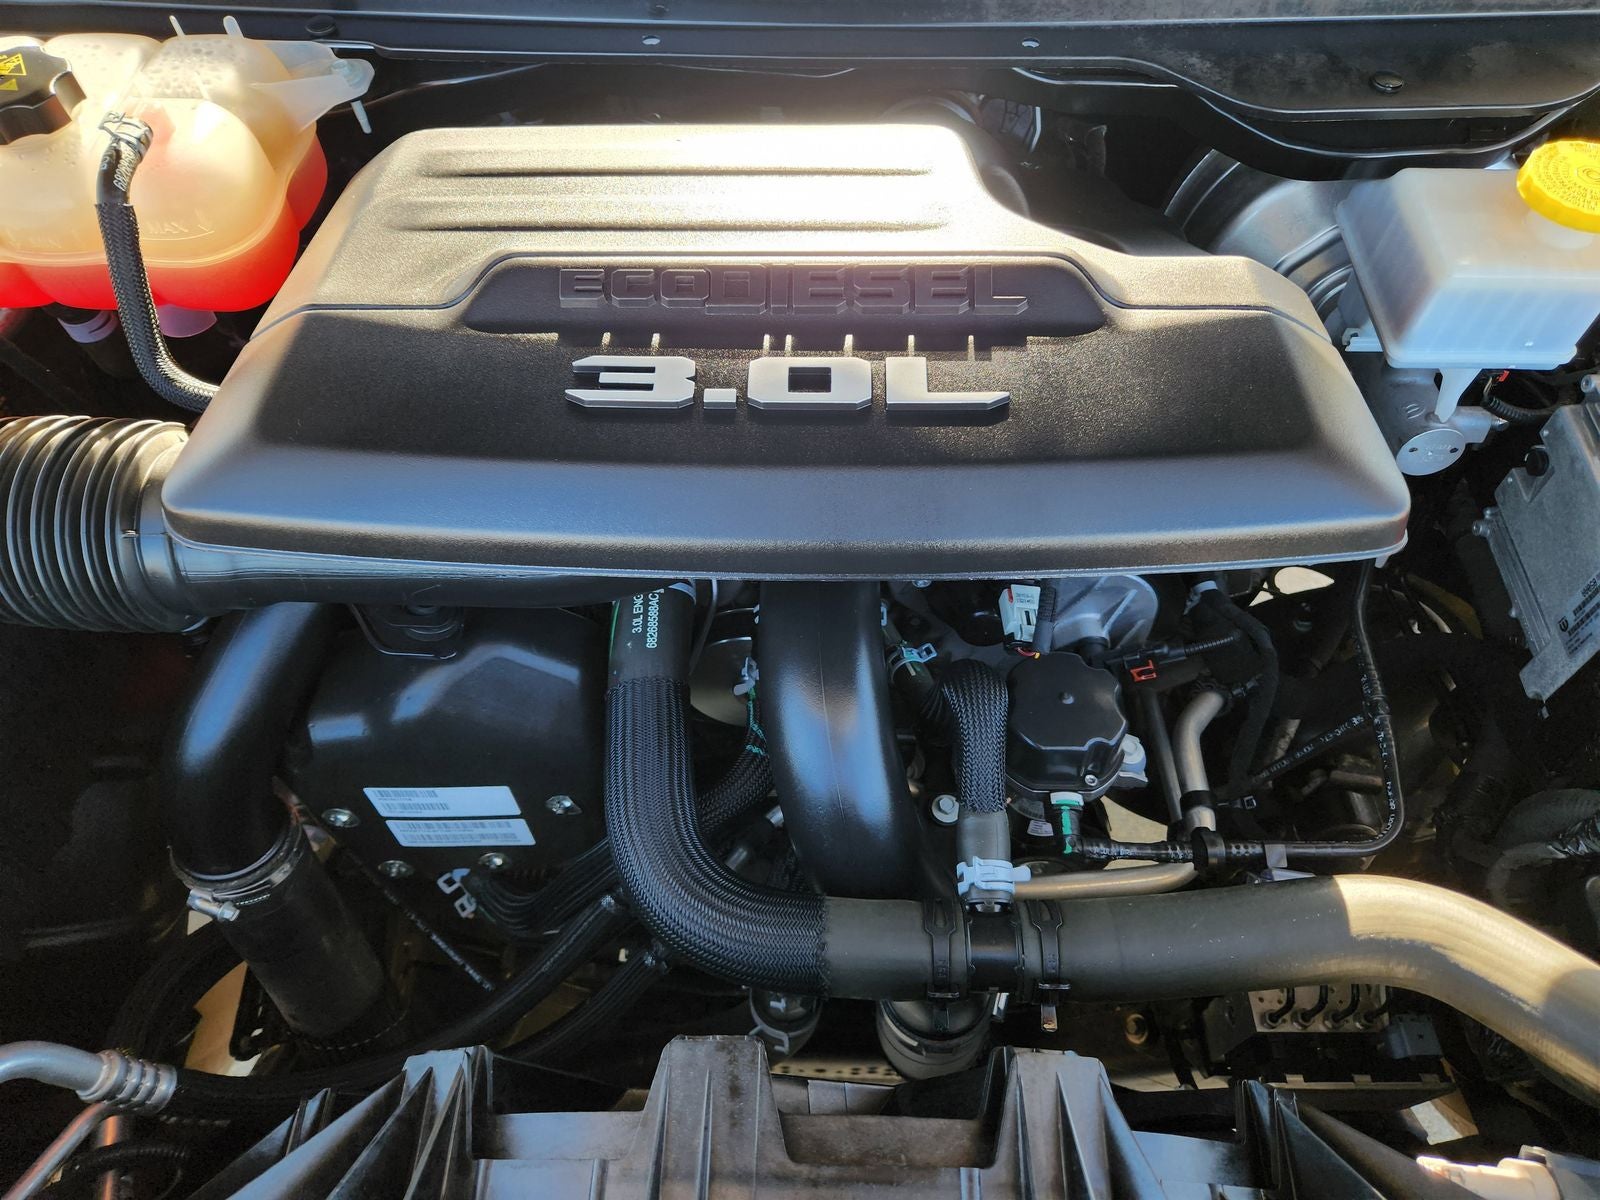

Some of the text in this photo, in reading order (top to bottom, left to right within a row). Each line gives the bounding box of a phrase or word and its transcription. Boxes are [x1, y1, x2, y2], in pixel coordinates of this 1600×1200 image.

[559, 263, 1029, 315] ECODIESEL
[565, 355, 1010, 409] 3.0L
[632, 615, 643, 633] 3.0L
[646, 593, 659, 648] 68268588AC
